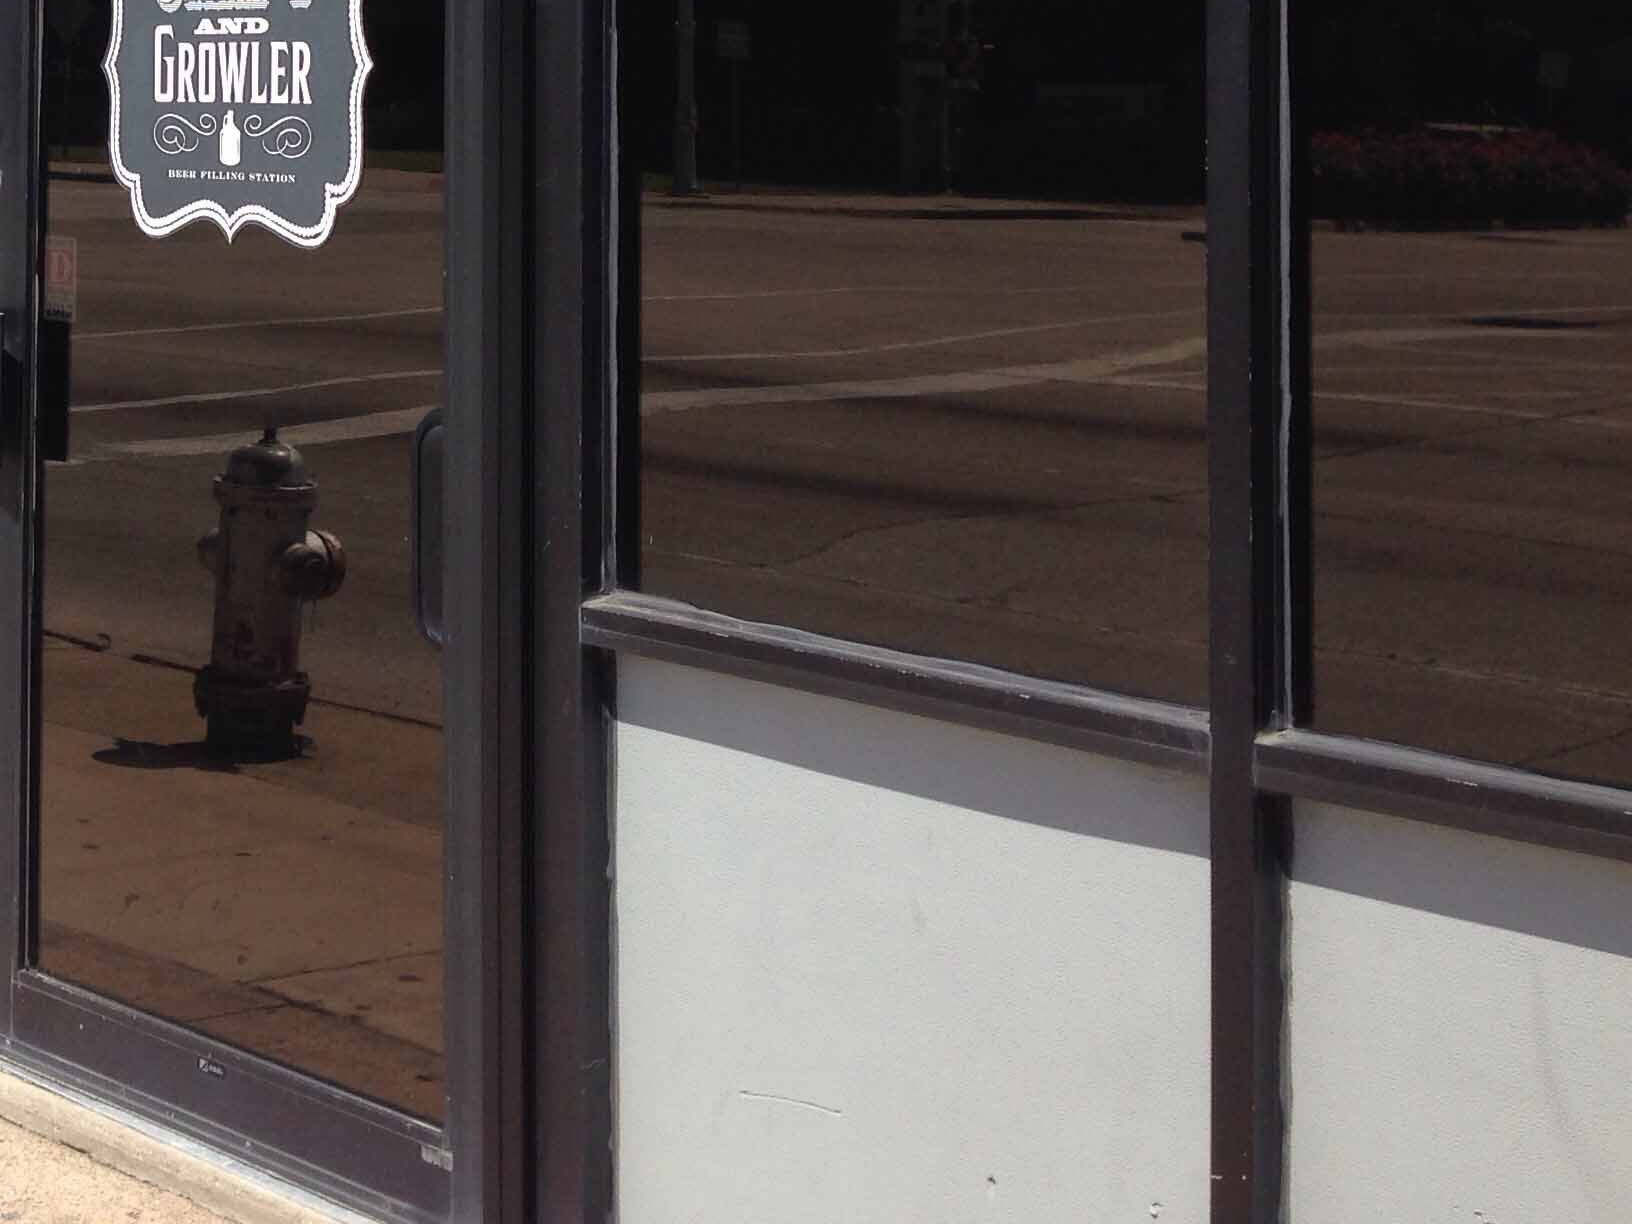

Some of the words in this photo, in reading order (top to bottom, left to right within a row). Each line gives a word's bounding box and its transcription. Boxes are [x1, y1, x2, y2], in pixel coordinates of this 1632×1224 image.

[193, 17, 269, 35] AND
[154, 24, 312, 104] GROWLER
[168, 169, 196, 179] BEER
[200, 171, 245, 181] FILLING
[249, 173, 296, 183] STATION
